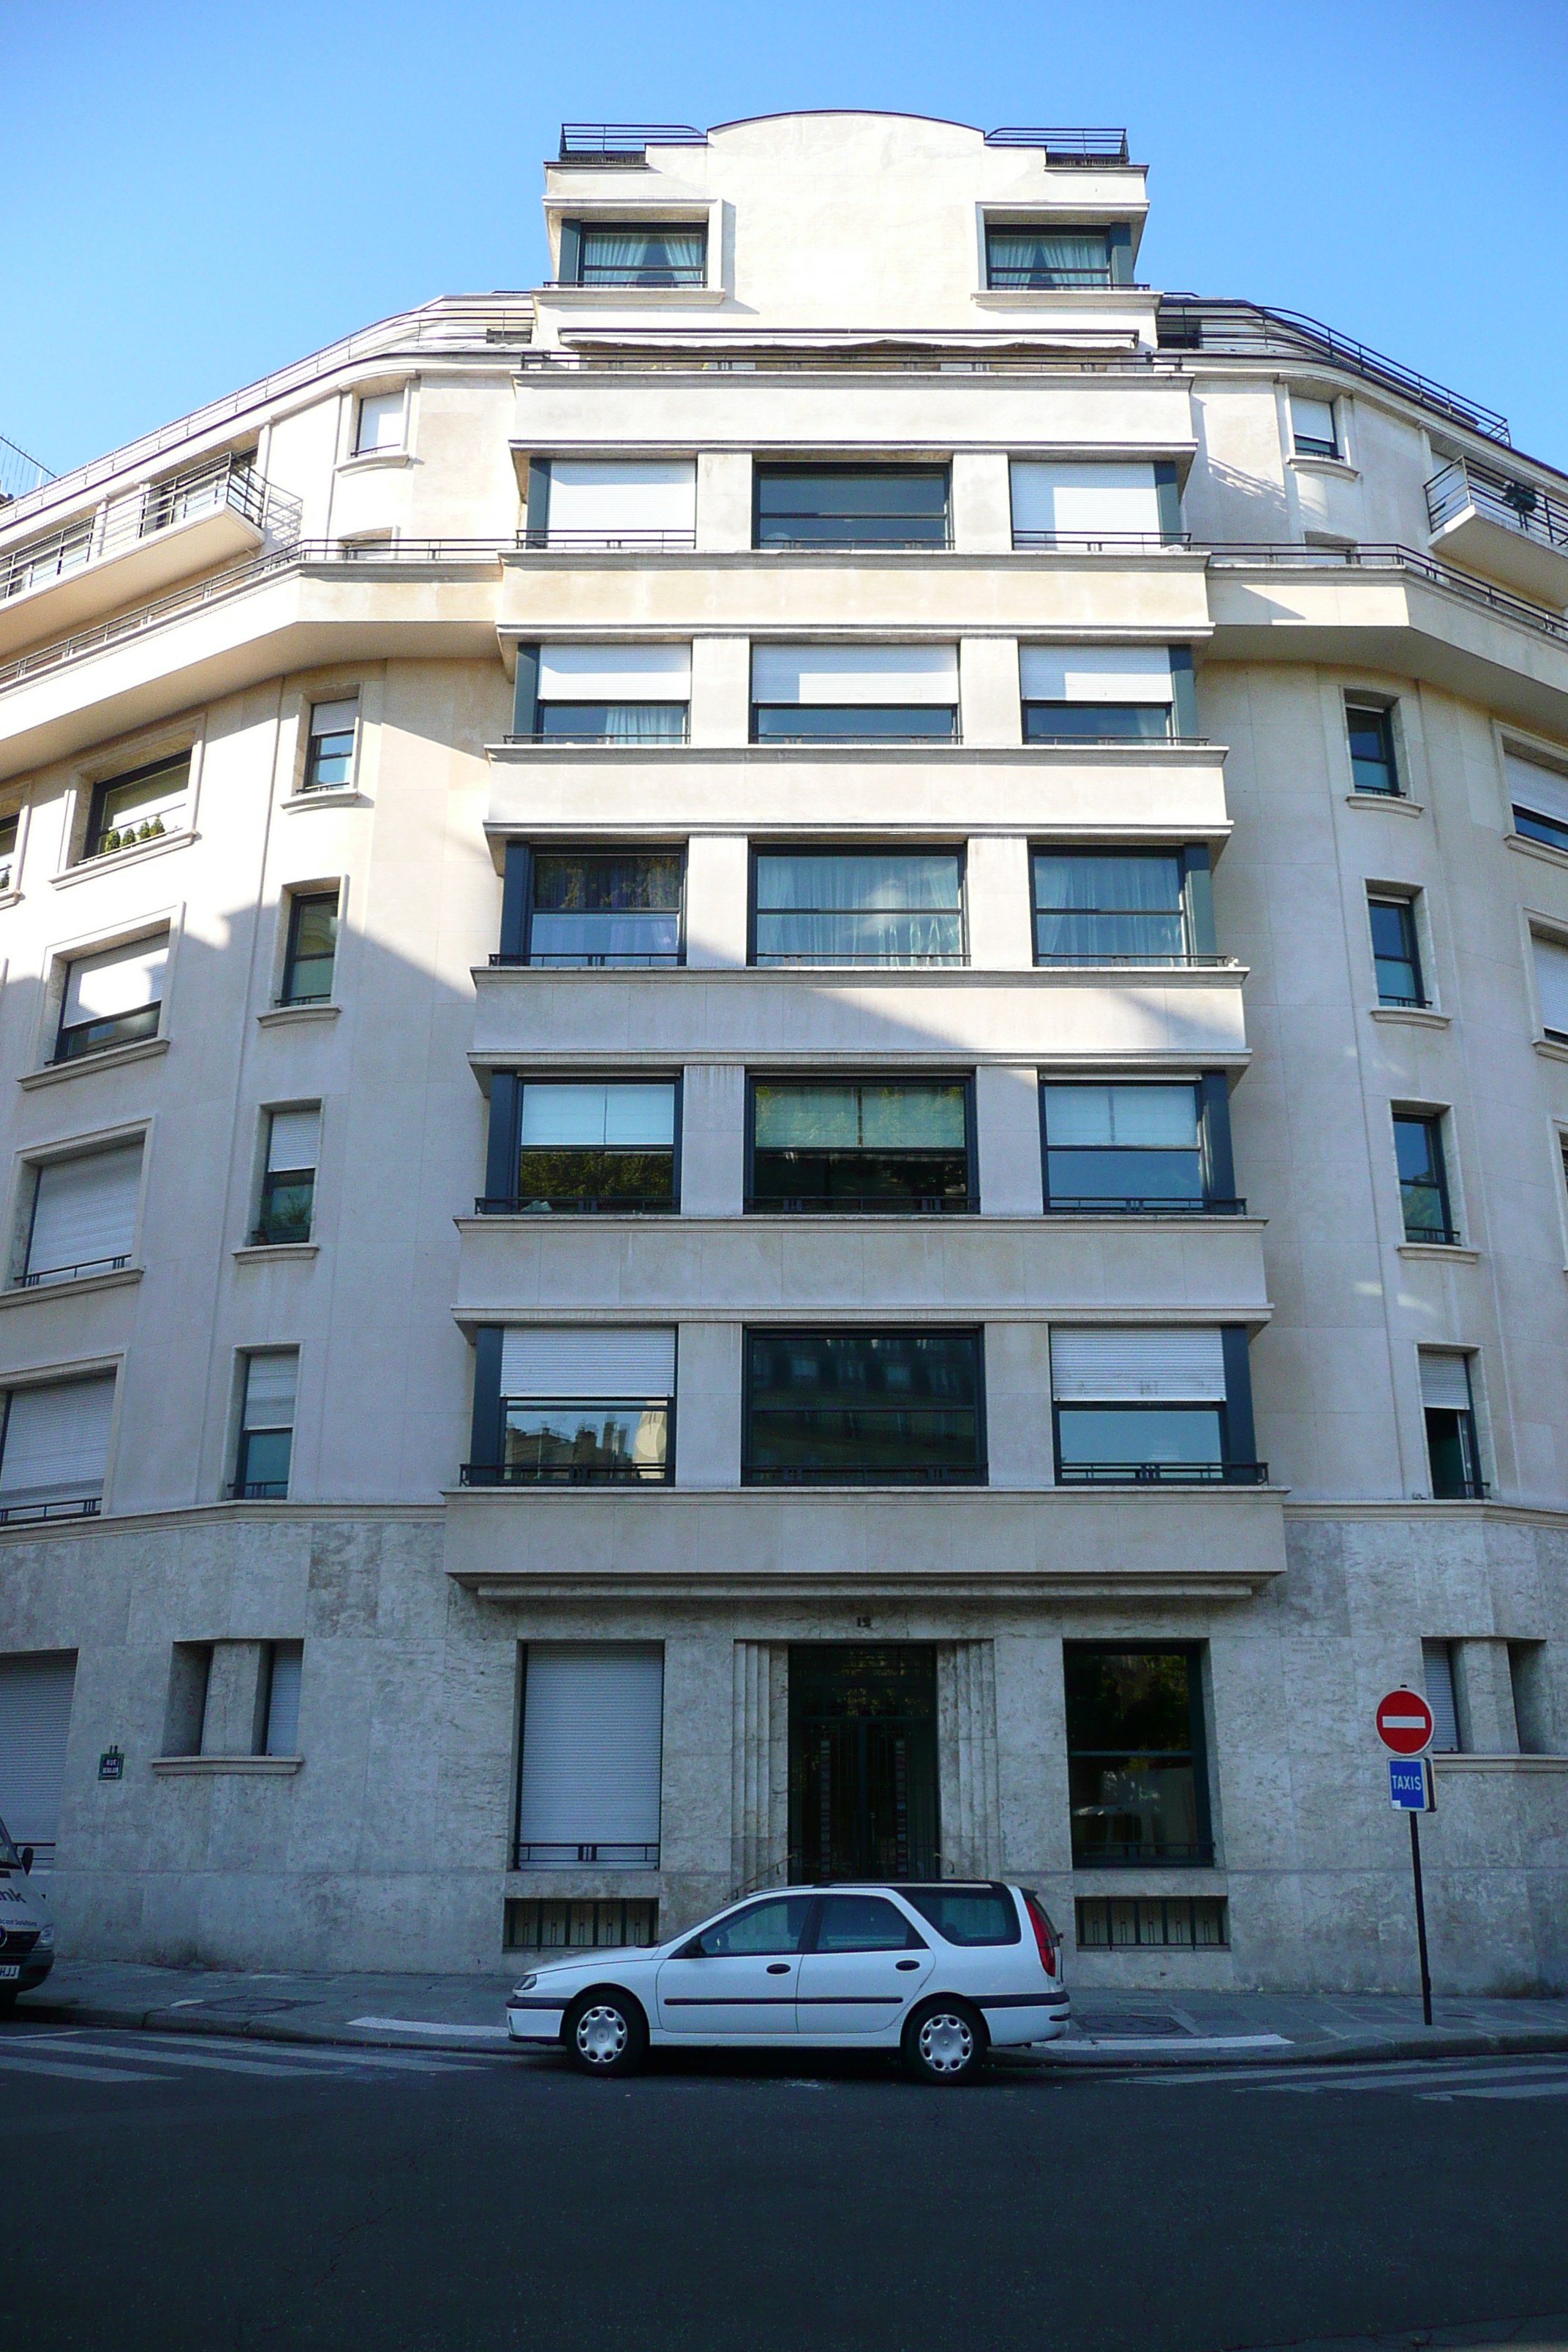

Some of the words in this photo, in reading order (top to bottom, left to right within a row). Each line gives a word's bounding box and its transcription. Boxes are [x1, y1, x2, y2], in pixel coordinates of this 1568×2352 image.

[856, 1617, 871, 1627] 12
[1392, 1775, 1422, 1790] TAXIS
[0, 1888, 27, 1903] nk
